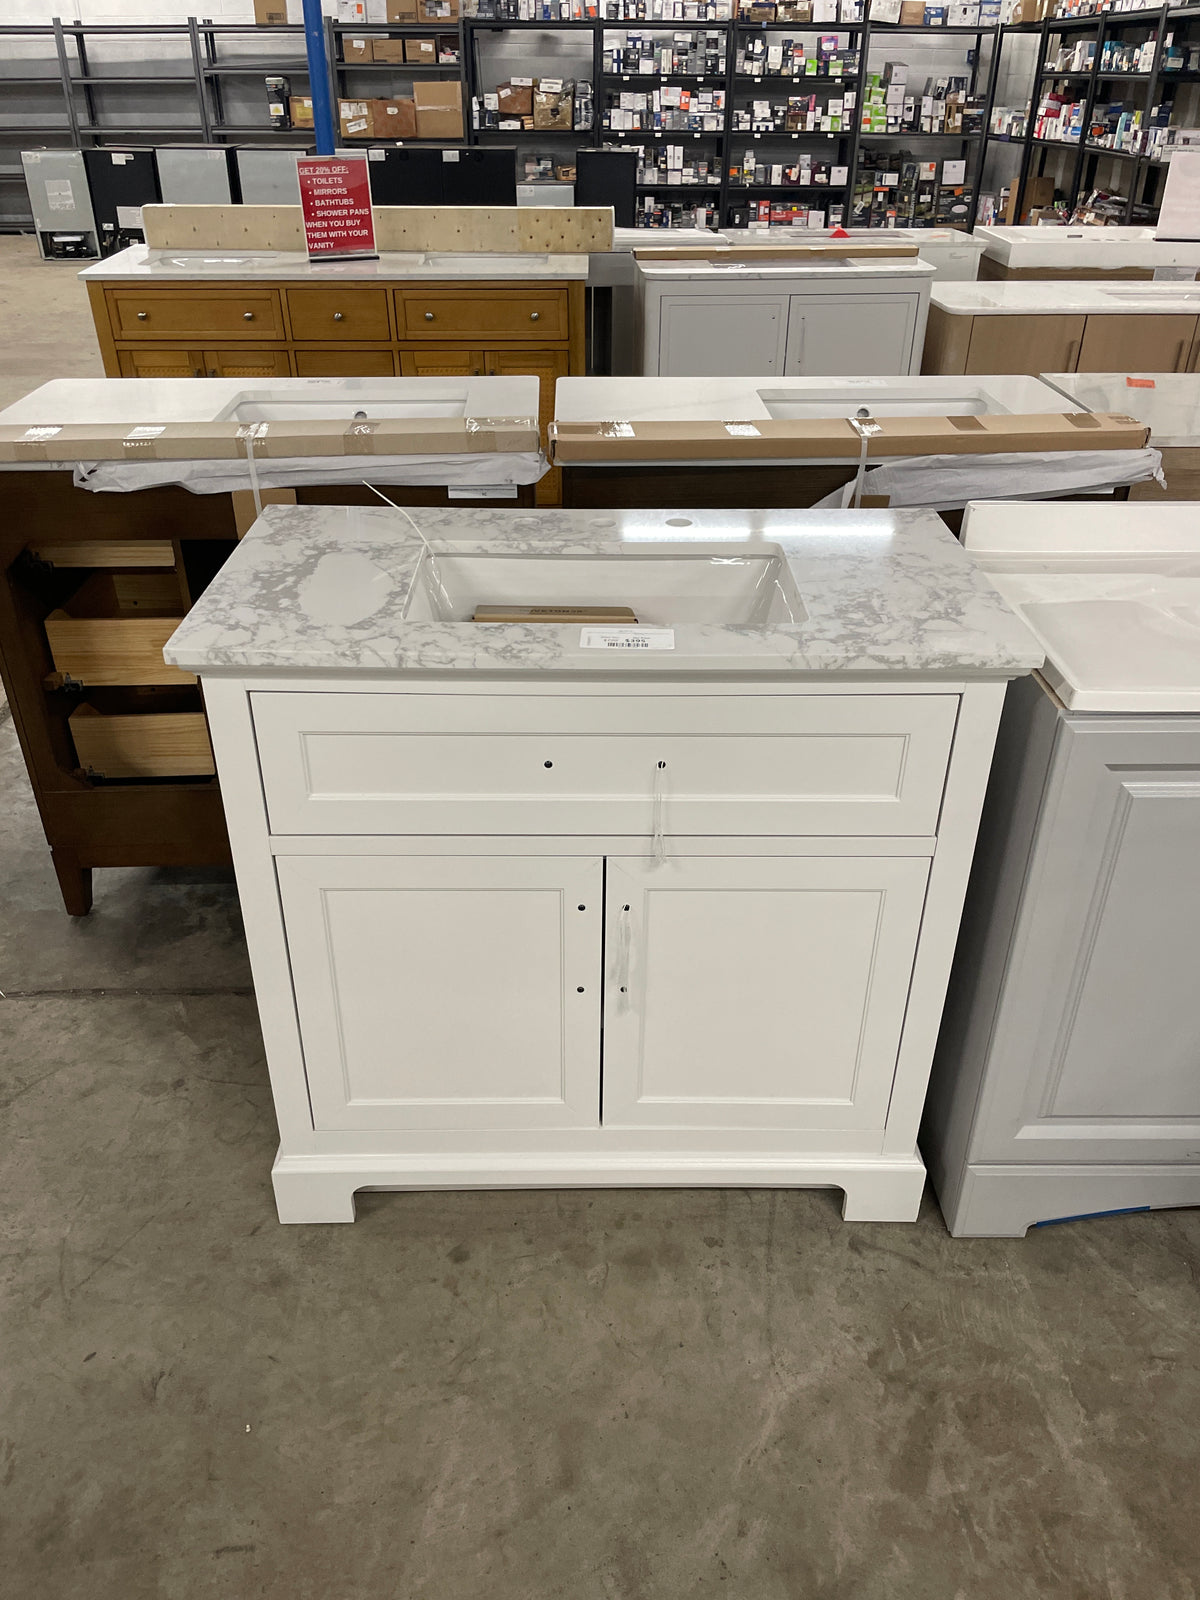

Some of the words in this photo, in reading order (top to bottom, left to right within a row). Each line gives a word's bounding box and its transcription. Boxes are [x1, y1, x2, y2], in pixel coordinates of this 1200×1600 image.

[299, 167, 314, 175] GET
[315, 166, 330, 174] 20%
[313, 188, 347, 196] MIRRORS
[314, 198, 354, 207] BATHTUBS
[316, 209, 348, 217] SHOWER
[349, 208, 370, 216] PANS
[307, 231, 328, 239] THEM
[348, 229, 369, 237] YOUR
[308, 241, 335, 249] VANITY
